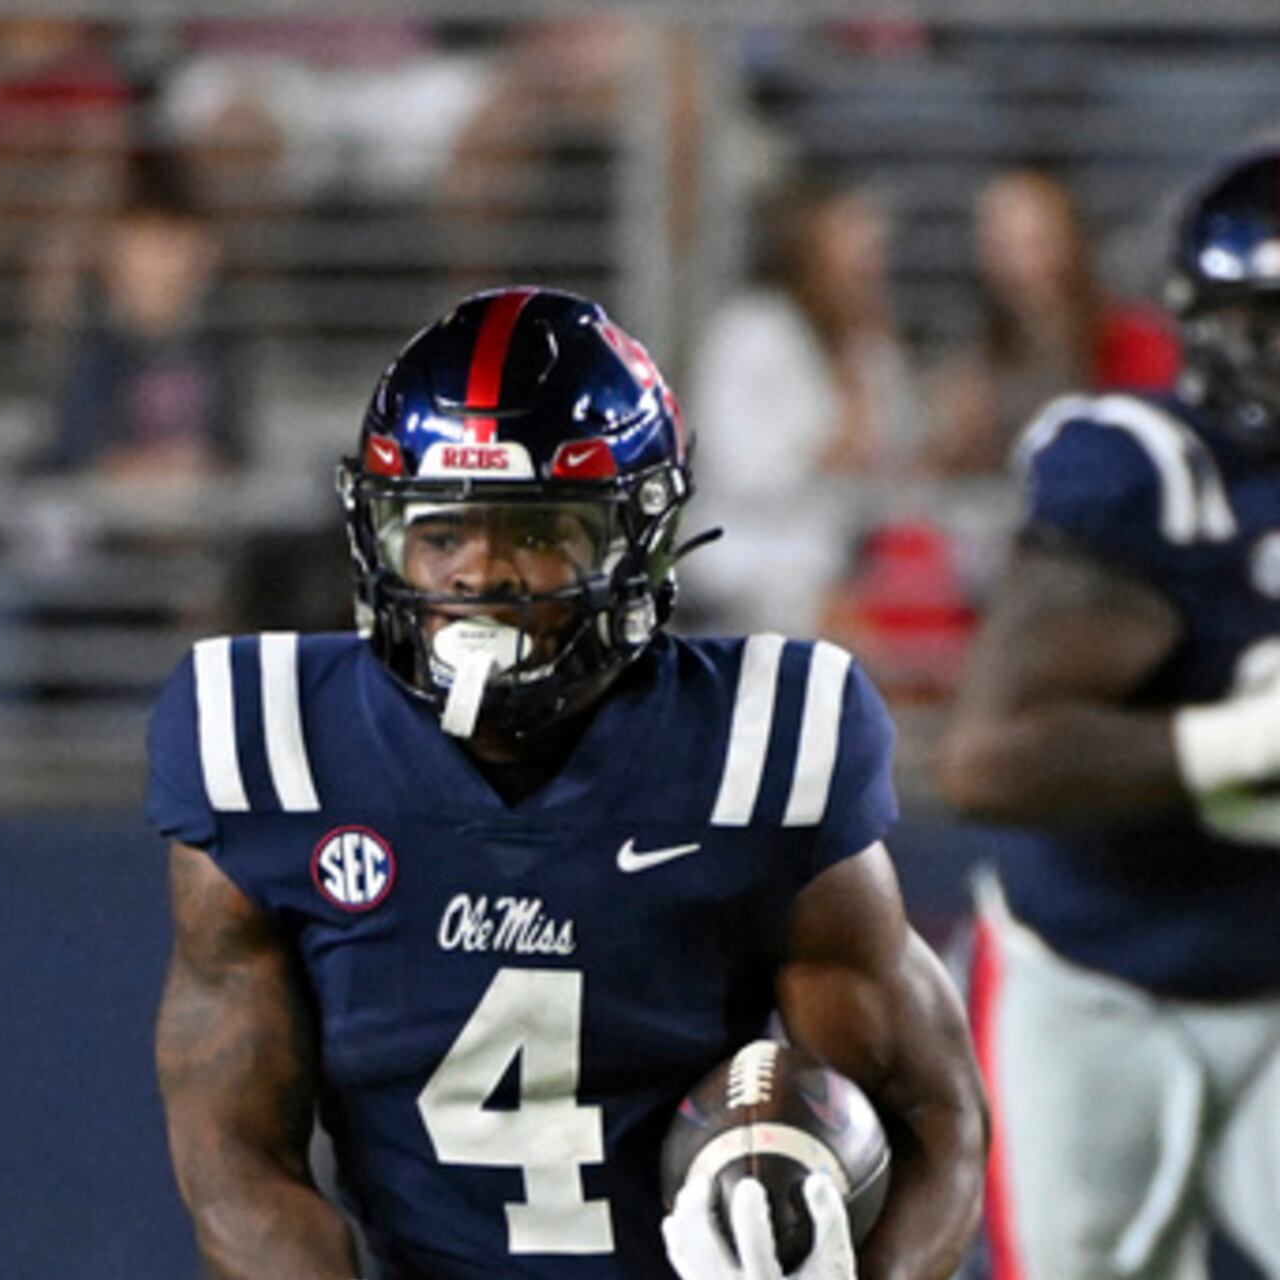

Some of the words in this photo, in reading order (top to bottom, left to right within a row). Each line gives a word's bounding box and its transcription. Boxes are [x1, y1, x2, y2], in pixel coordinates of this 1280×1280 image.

[318, 831, 388, 905] SEC
[437, 893, 495, 952] Ole
[492, 895, 578, 955] Miss
[416, 967, 615, 1255] 4
